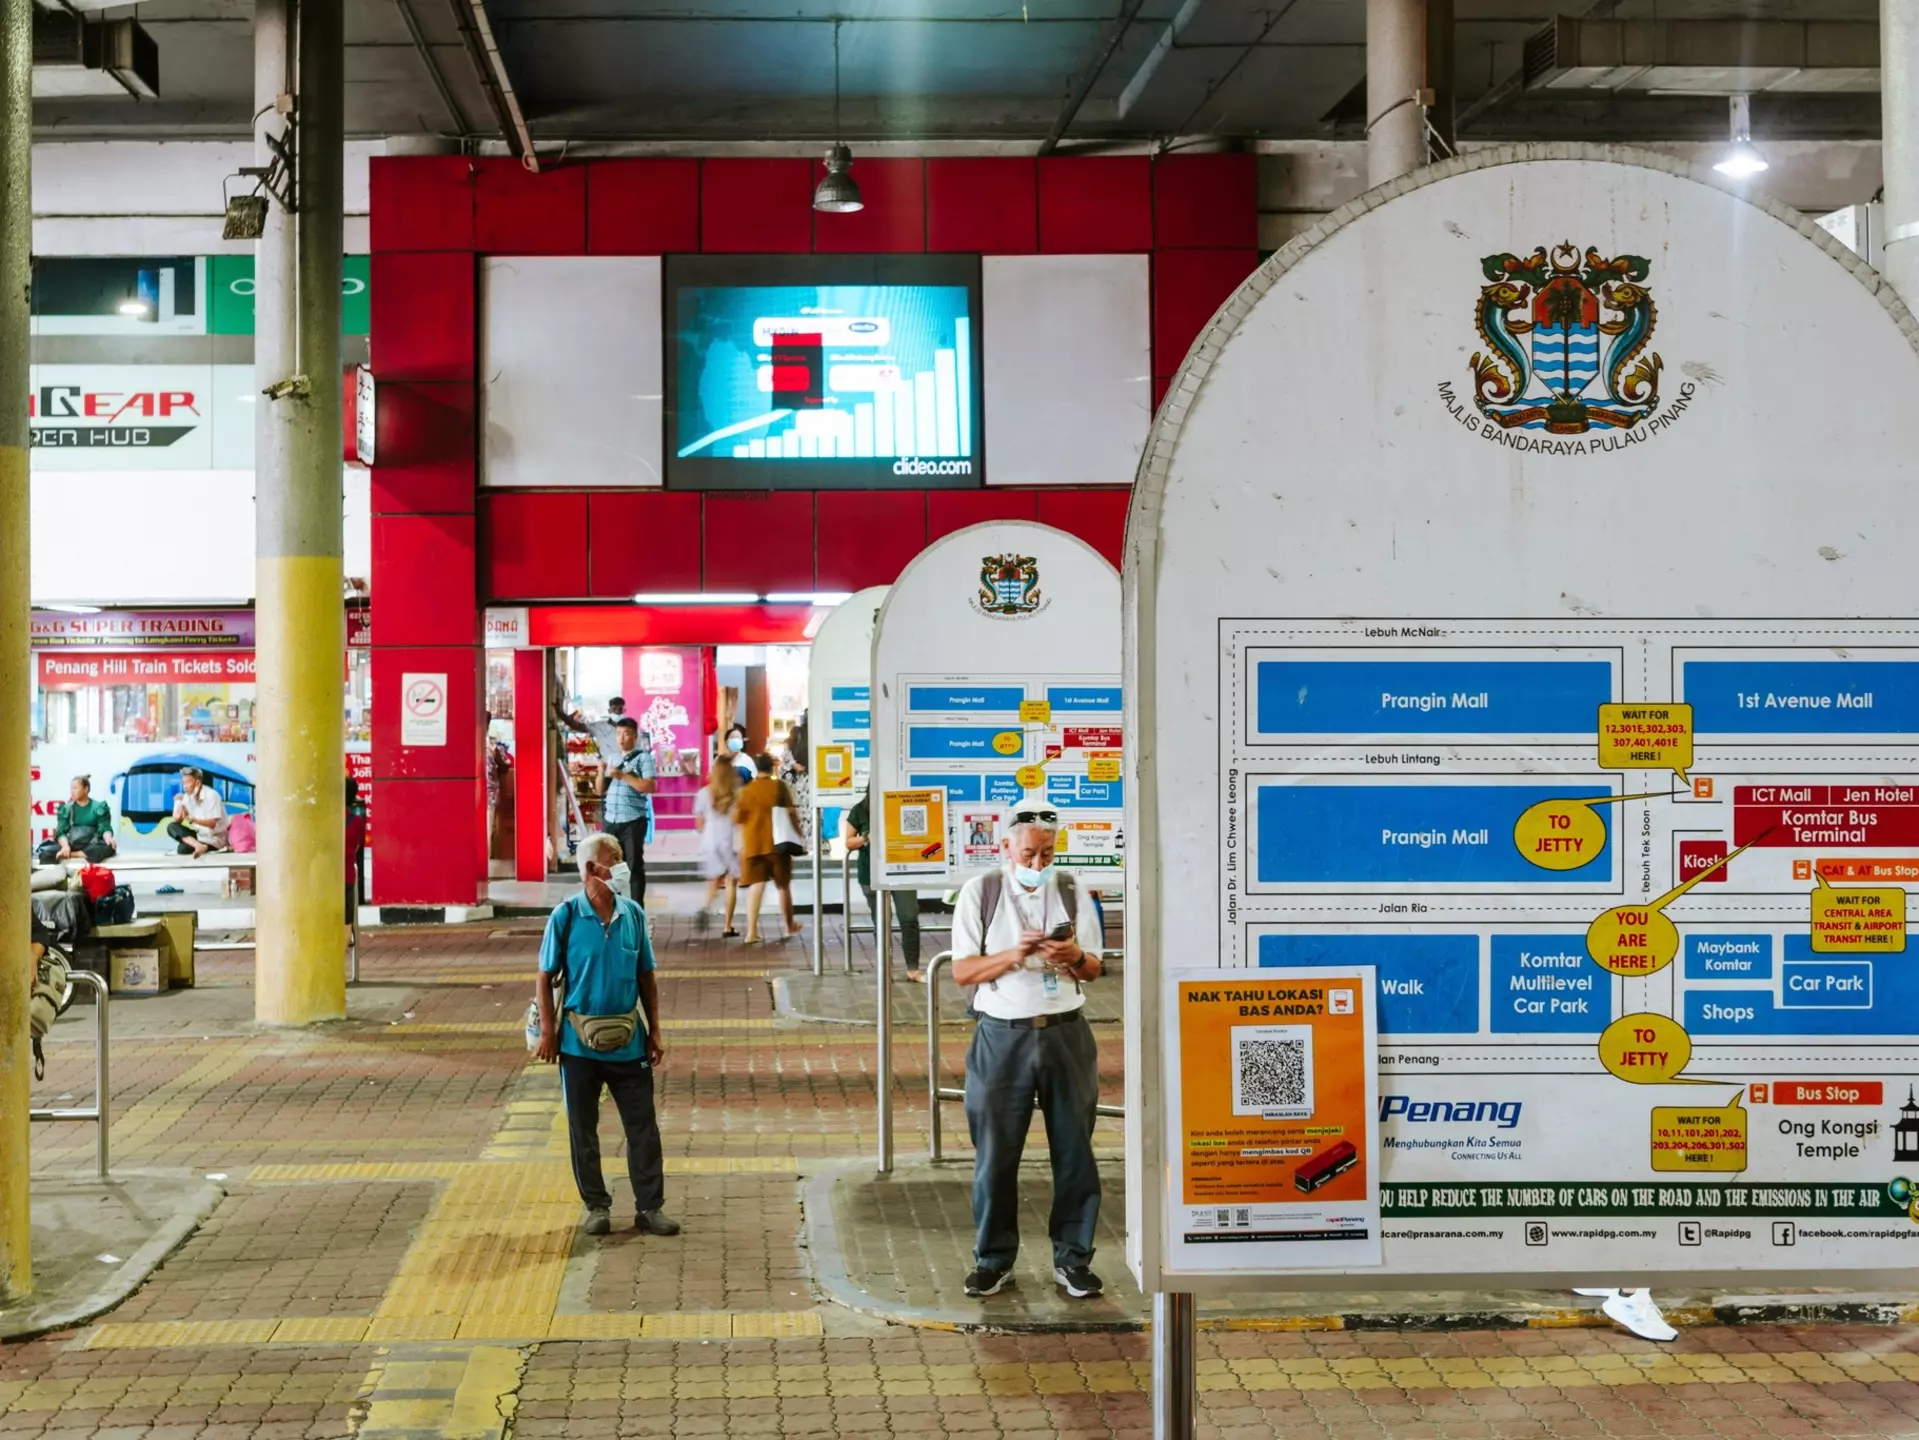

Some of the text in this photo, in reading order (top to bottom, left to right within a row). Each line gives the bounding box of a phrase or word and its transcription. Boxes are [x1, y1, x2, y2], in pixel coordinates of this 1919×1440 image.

[1437, 381, 1696, 456] MAJLIS BANDARAYA PULAU PINANG
[90, 429, 150, 445] HUB
[70, 619, 133, 632] SUPER
[139, 618, 224, 632] TRADING
[1365, 627, 1440, 638] Lebuh McNair
[45, 660, 98, 676] Penang
[103, 659, 127, 674] Hill
[132, 659, 167, 673] Train
[171, 658, 222, 673] Tickets
[1381, 692, 1488, 712] Prangin Mall
[1737, 693, 1873, 709] 1st Avenue Mall
[1622, 711, 1669, 719] WAIT FOR
[1605, 724, 1687, 734] 12,301E,302,303,
[1613, 738, 1678, 748] 307,401,401E
[1365, 754, 1441, 766] Lebuh Lintang
[1752, 788, 1811, 802] ICT Mall
[1843, 788, 1914, 802] Jen Hotel
[1549, 815, 1570, 829] TO
[1782, 810, 1878, 826] Komtar Bus
[1381, 828, 1488, 849] Prangin Mall
[1793, 827, 1866, 843] Terminal
[1227, 767, 1239, 926] Jalan Dr. Lim Chwee Leong
[1536, 838, 1583, 853] JETTY
[1641, 809, 1651, 894] Lebuh Tek Soon
[1822, 865, 1919, 877] CAT & AT Bus Stop
[1836, 896, 1880, 905] WAIT FOR
[1378, 903, 1427, 913] Jalan Ria
[1824, 909, 1892, 918] CENTRAL AREA
[1616, 912, 1648, 926] YOU
[1814, 922, 1903, 930] TRANSIT & AIRPORT
[1617, 933, 1648, 947] ARE
[1824, 935, 1863, 943] TRANSIT
[1697, 941, 1760, 955] Maybank
[1520, 952, 1582, 969] Komtar
[1705, 959, 1752, 971] Komtar
[1381, 979, 1424, 995] Walk
[1510, 975, 1592, 991] Multilevel
[1789, 975, 1864, 991] Car Park
[1188, 989, 1323, 1003] NAK TAHU LOKASI
[1239, 1005, 1270, 1017] BAS
[1273, 1004, 1324, 1016] ANDA?
[1514, 998, 1588, 1014] Car Park
[1702, 1004, 1755, 1023] Shops
[1633, 1029, 1656, 1044] TO
[1378, 1053, 1440, 1066] lan Penang
[1620, 1052, 1669, 1066] JETTY
[1796, 1087, 1860, 1103] Bus Stop
[1379, 1095, 1523, 1129] Penang
[1677, 1116, 1721, 1124] WAIT FOR
[1306, 1127, 1342, 1135] menjejaki
[1778, 1119, 1878, 1138] Ong Kongsi
[1383, 1136, 1522, 1150] Menghubungkan Kita Semua
[1242, 1148, 1284, 1156] mengimbas
[1796, 1142, 1860, 1161] Temple
[1380, 1188, 1881, 1208] OU HELP REDUCE THE NUMBER OF CARS ON THE ROAD AND THE EMISSIONS IN THE AIR
[1552, 1229, 1657, 1240] www.rapidpg.com.my
[1704, 1229, 1752, 1240] @Rapidpg
